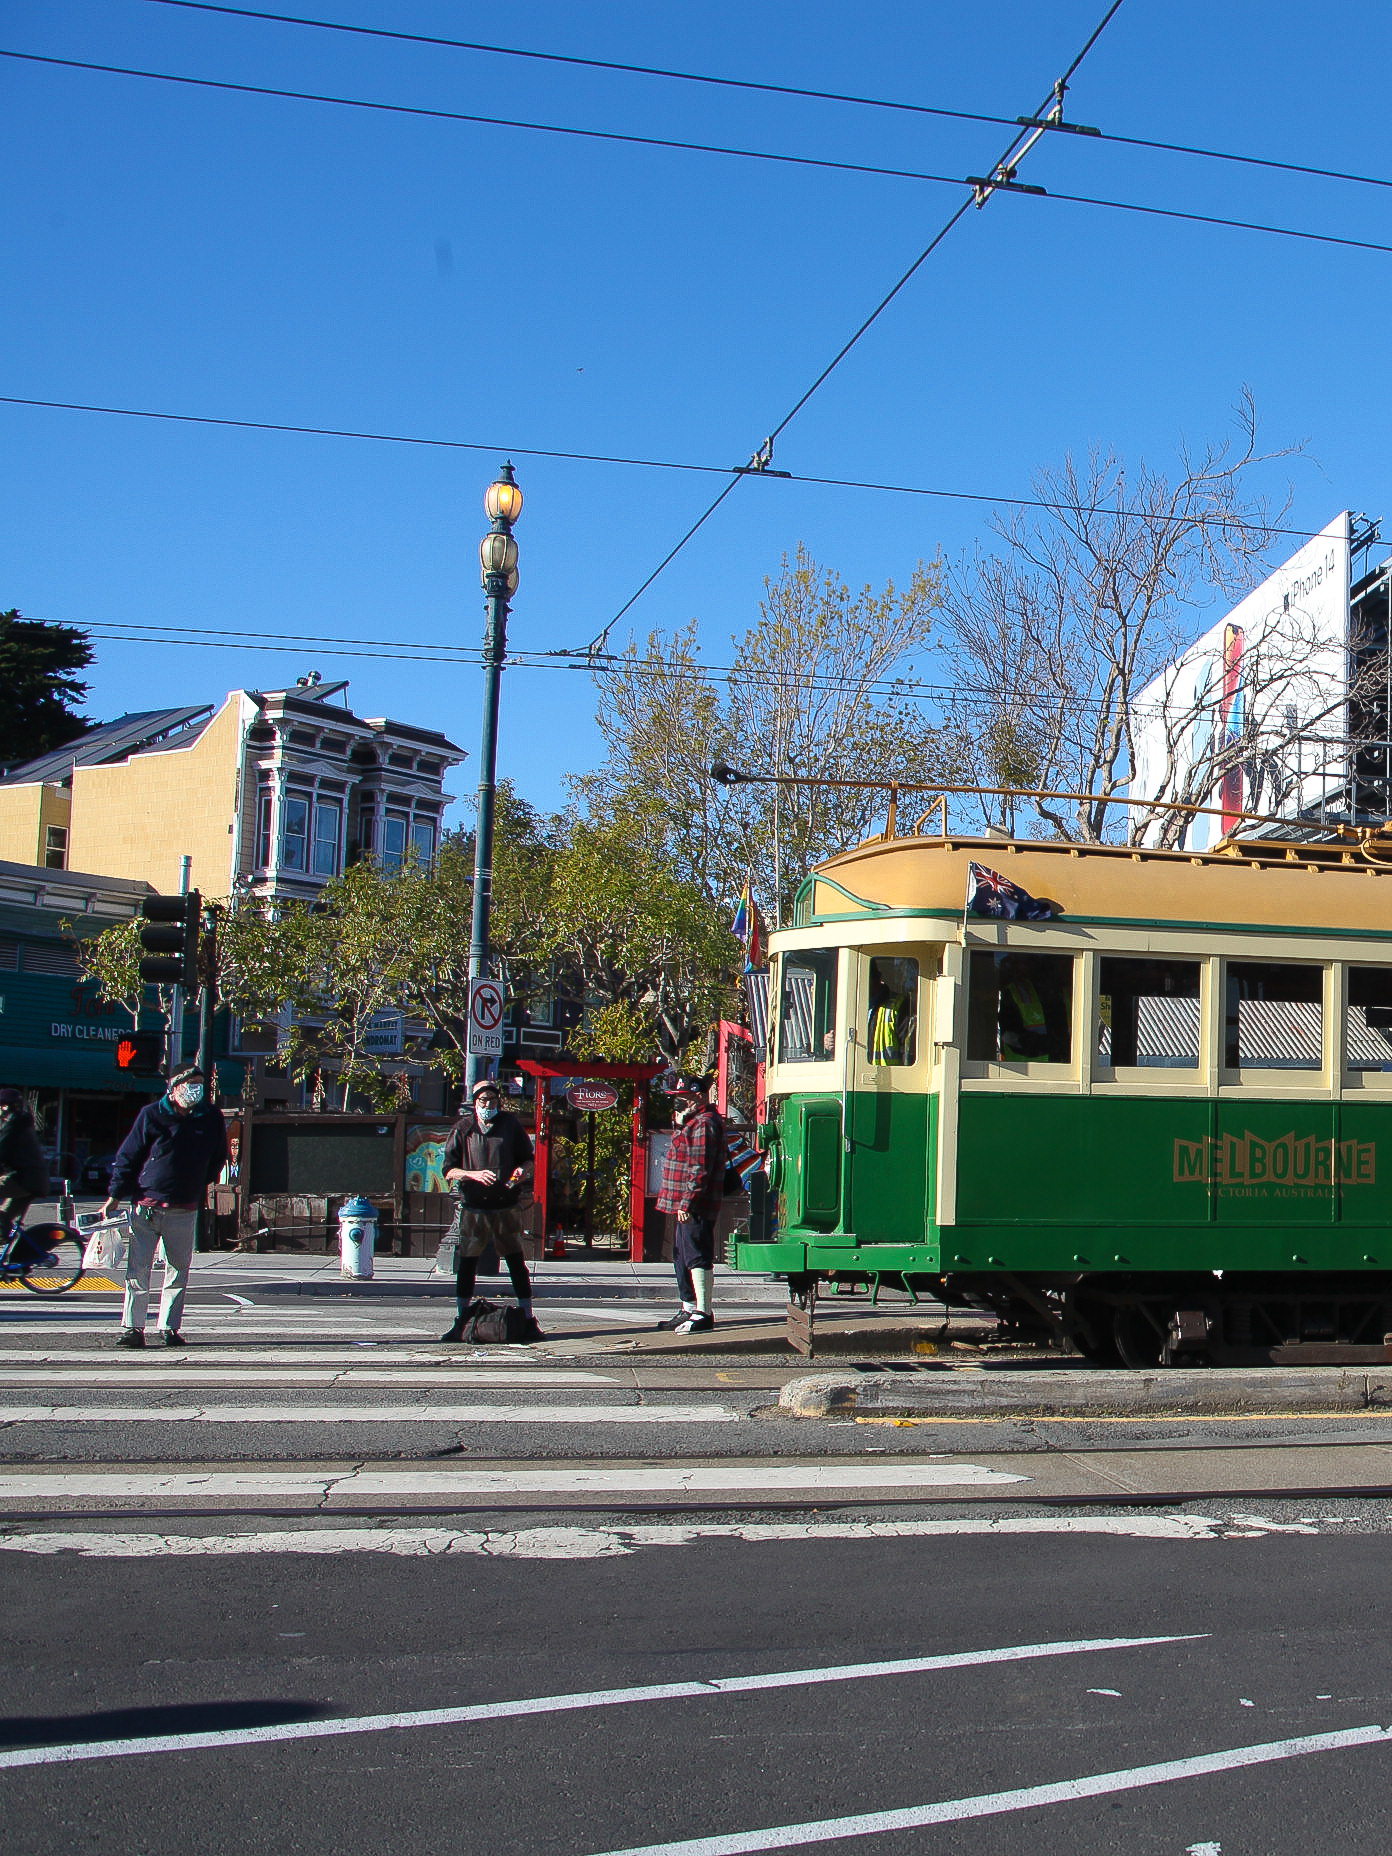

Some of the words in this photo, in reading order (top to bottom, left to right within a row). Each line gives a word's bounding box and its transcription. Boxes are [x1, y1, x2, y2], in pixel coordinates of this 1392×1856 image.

[1290, 566, 1323, 606] iPhone
[1324, 548, 1336, 579] 14
[51, 1022, 73, 1038] DRY
[472, 1034, 483, 1047] ON
[485, 1035, 500, 1049] RED
[1175, 1132, 1374, 1183] MELBOURNE
